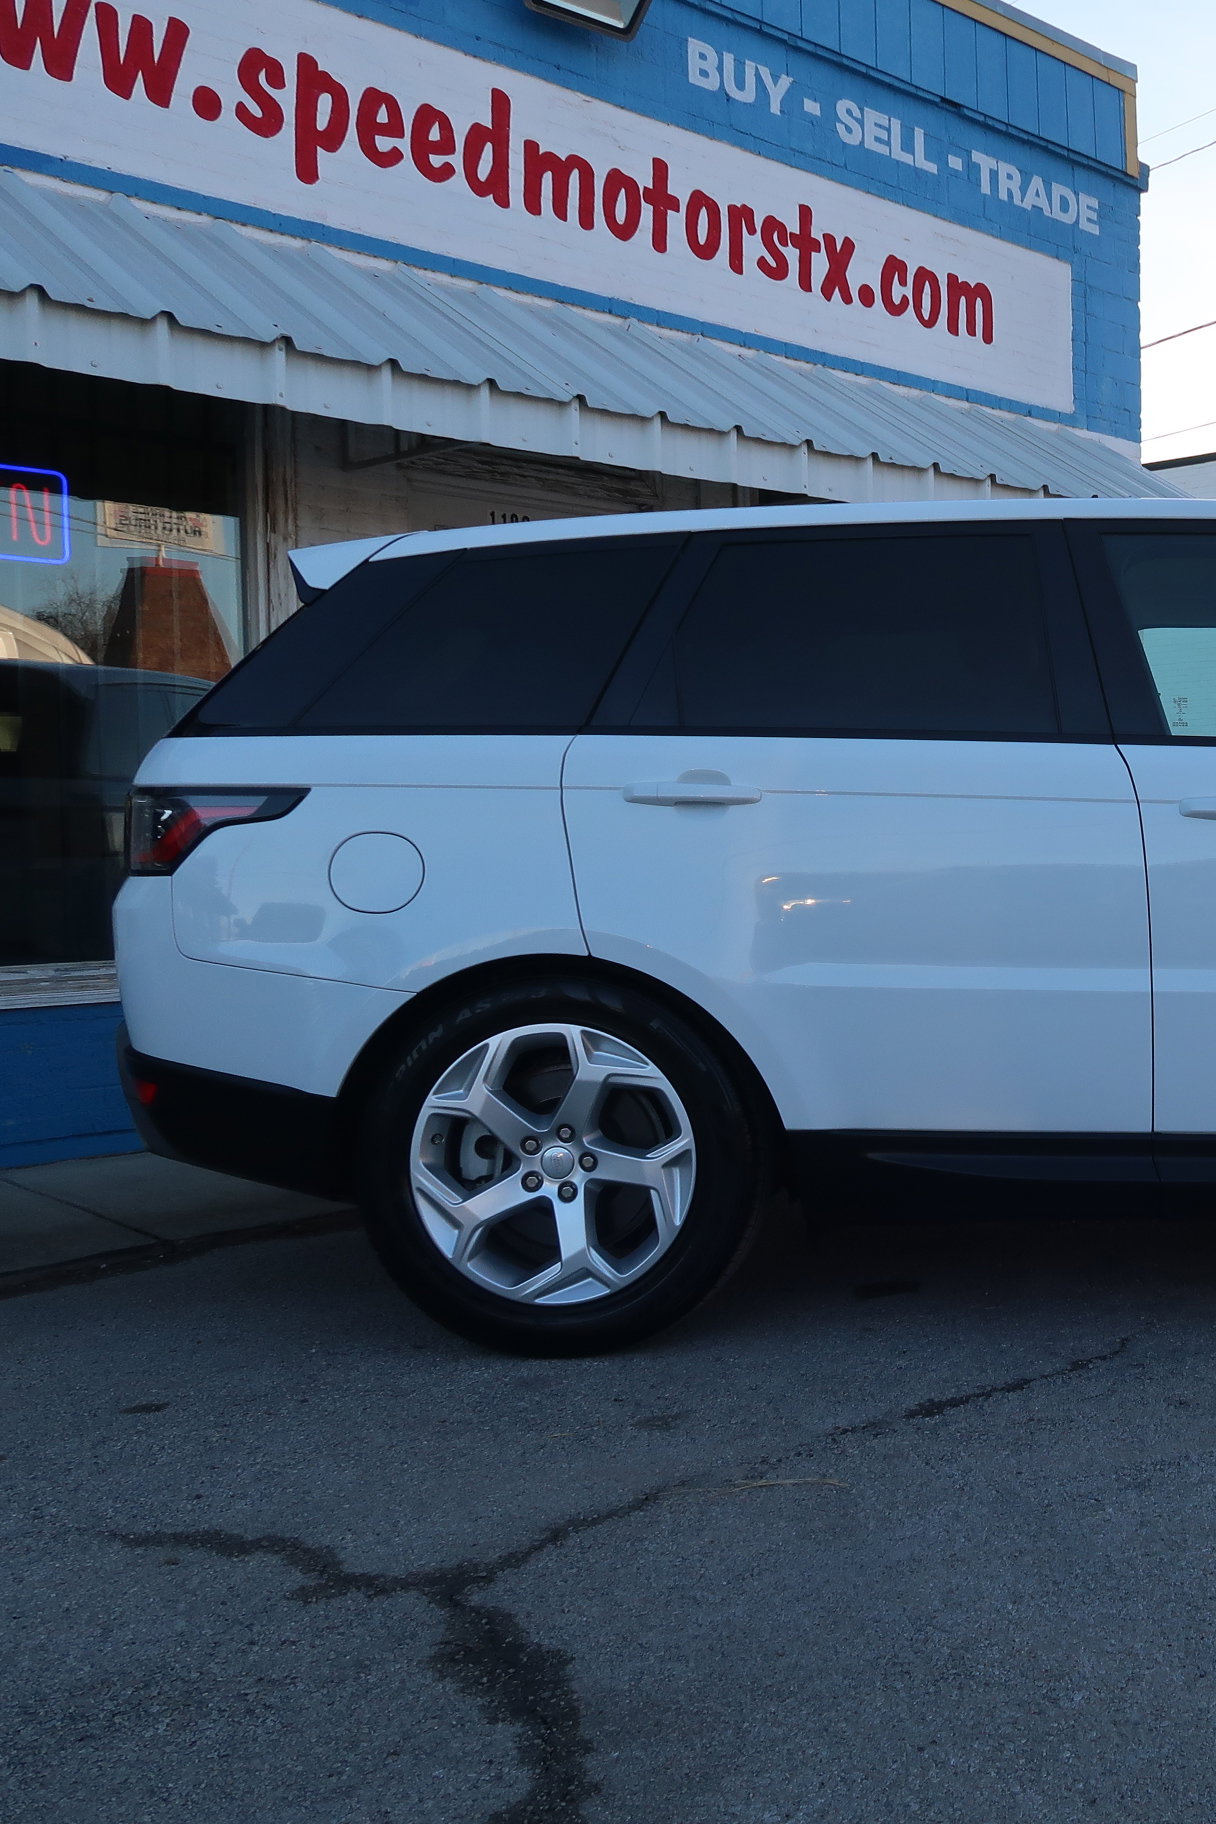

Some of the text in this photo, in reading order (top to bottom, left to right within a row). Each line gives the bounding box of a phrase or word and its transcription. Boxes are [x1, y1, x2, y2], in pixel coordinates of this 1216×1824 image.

[687, 37, 794, 115] BUY
[835, 98, 938, 174] SELL
[971, 149, 1100, 236] TRADE
